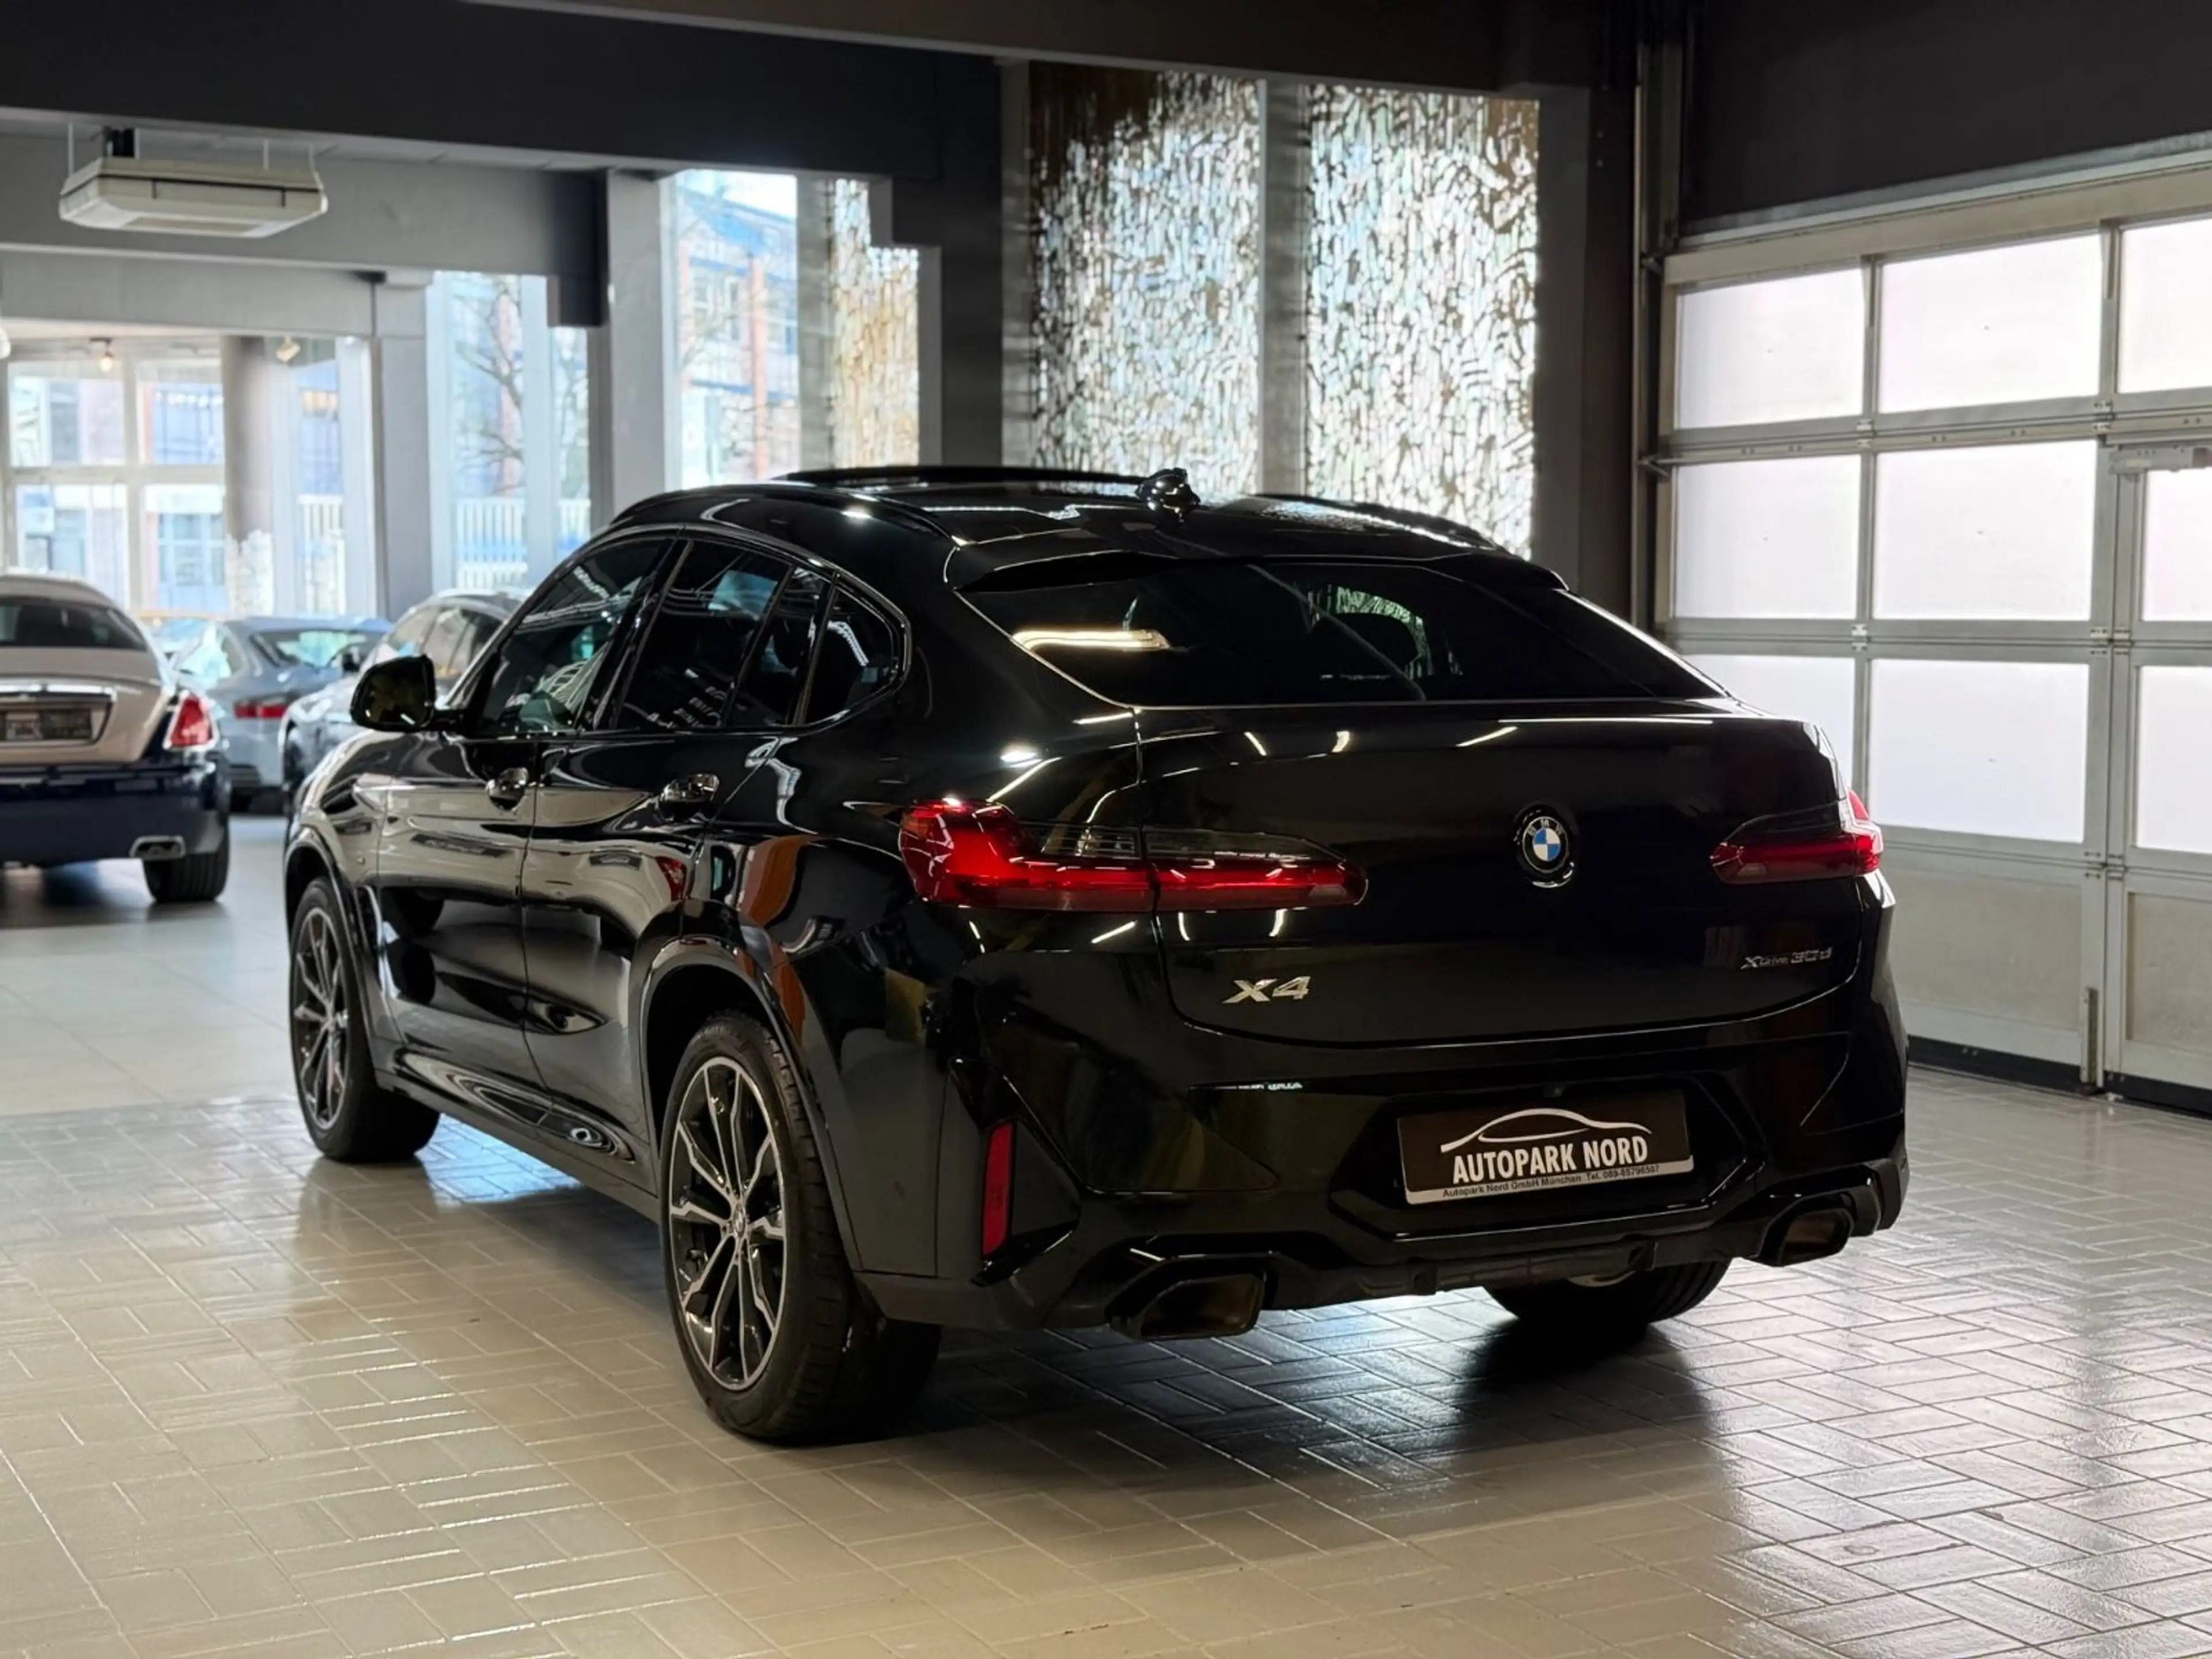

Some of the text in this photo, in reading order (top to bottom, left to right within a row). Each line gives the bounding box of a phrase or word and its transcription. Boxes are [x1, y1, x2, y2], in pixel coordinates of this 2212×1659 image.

[1527, 819, 1563, 836] BMW
[1222, 975, 1312, 1003] X4
[1453, 1135, 1648, 1184] AUTOPARK NORD
[1442, 1186, 1484, 1198] Autopark
[1486, 1183, 1510, 1192] Nord
[1511, 1178, 1539, 1189] GmbH
